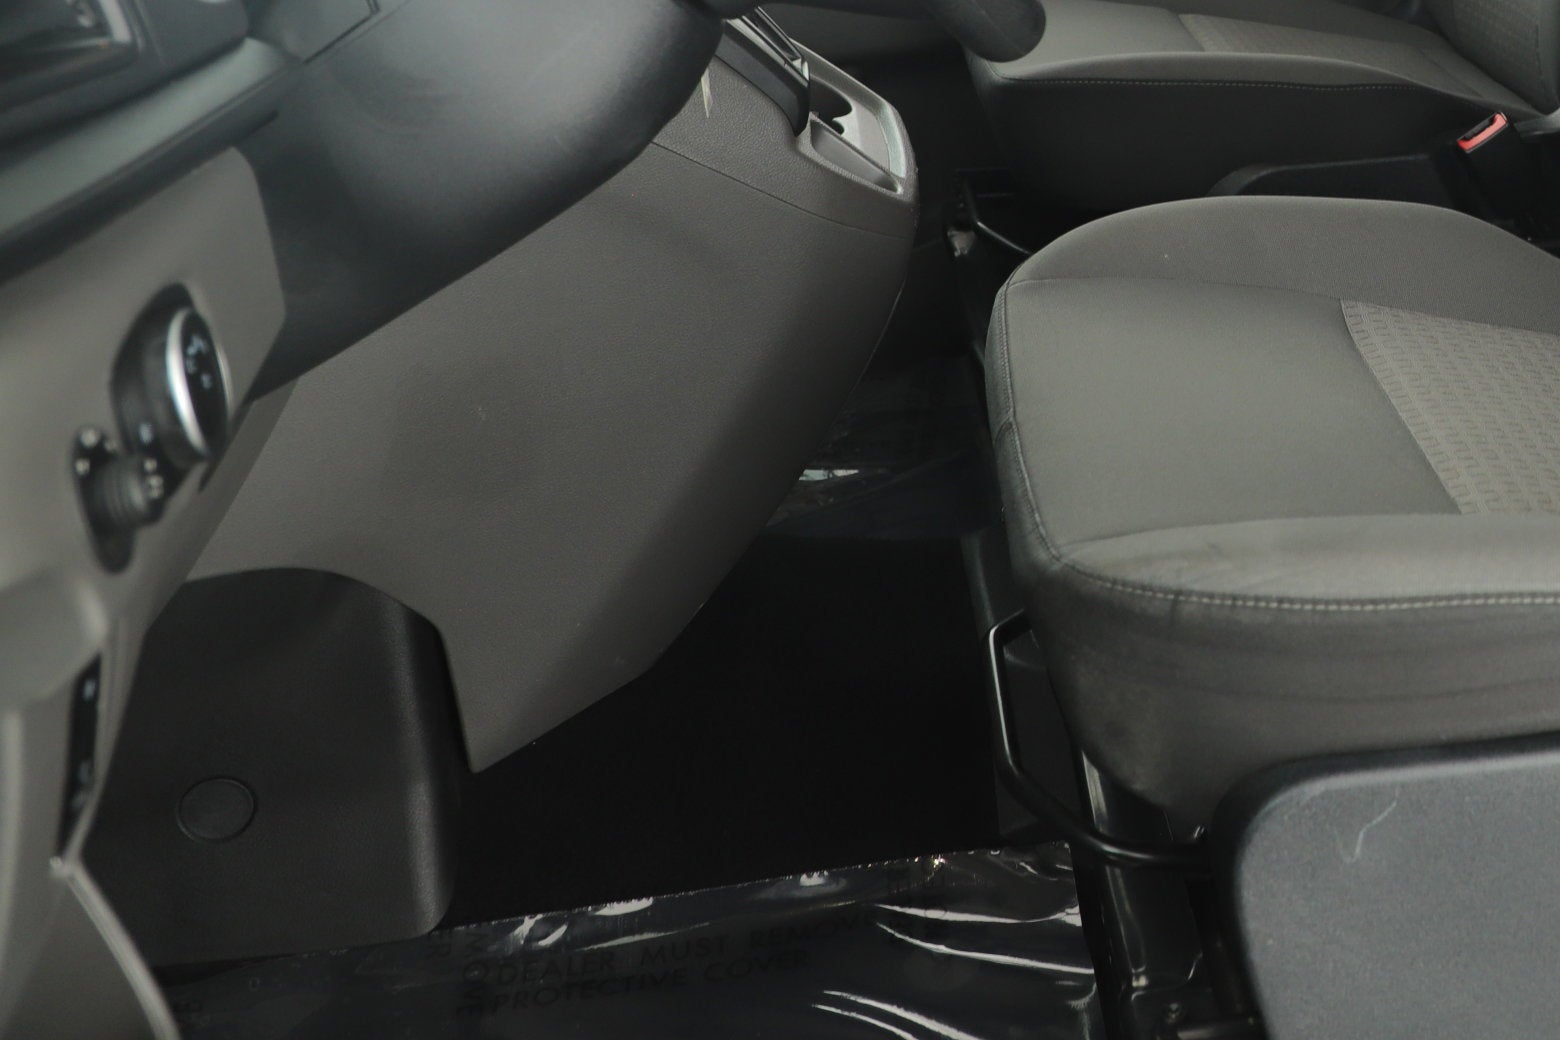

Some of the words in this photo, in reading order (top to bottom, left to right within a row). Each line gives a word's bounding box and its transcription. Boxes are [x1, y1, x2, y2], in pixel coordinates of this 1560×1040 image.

[494, 968, 688, 1014] PROTECTIVE
[703, 949, 808, 983] COVER
[498, 950, 616, 986] DEALER
[640, 934, 729, 966] MUST
[751, 910, 877, 950] REMOVE
